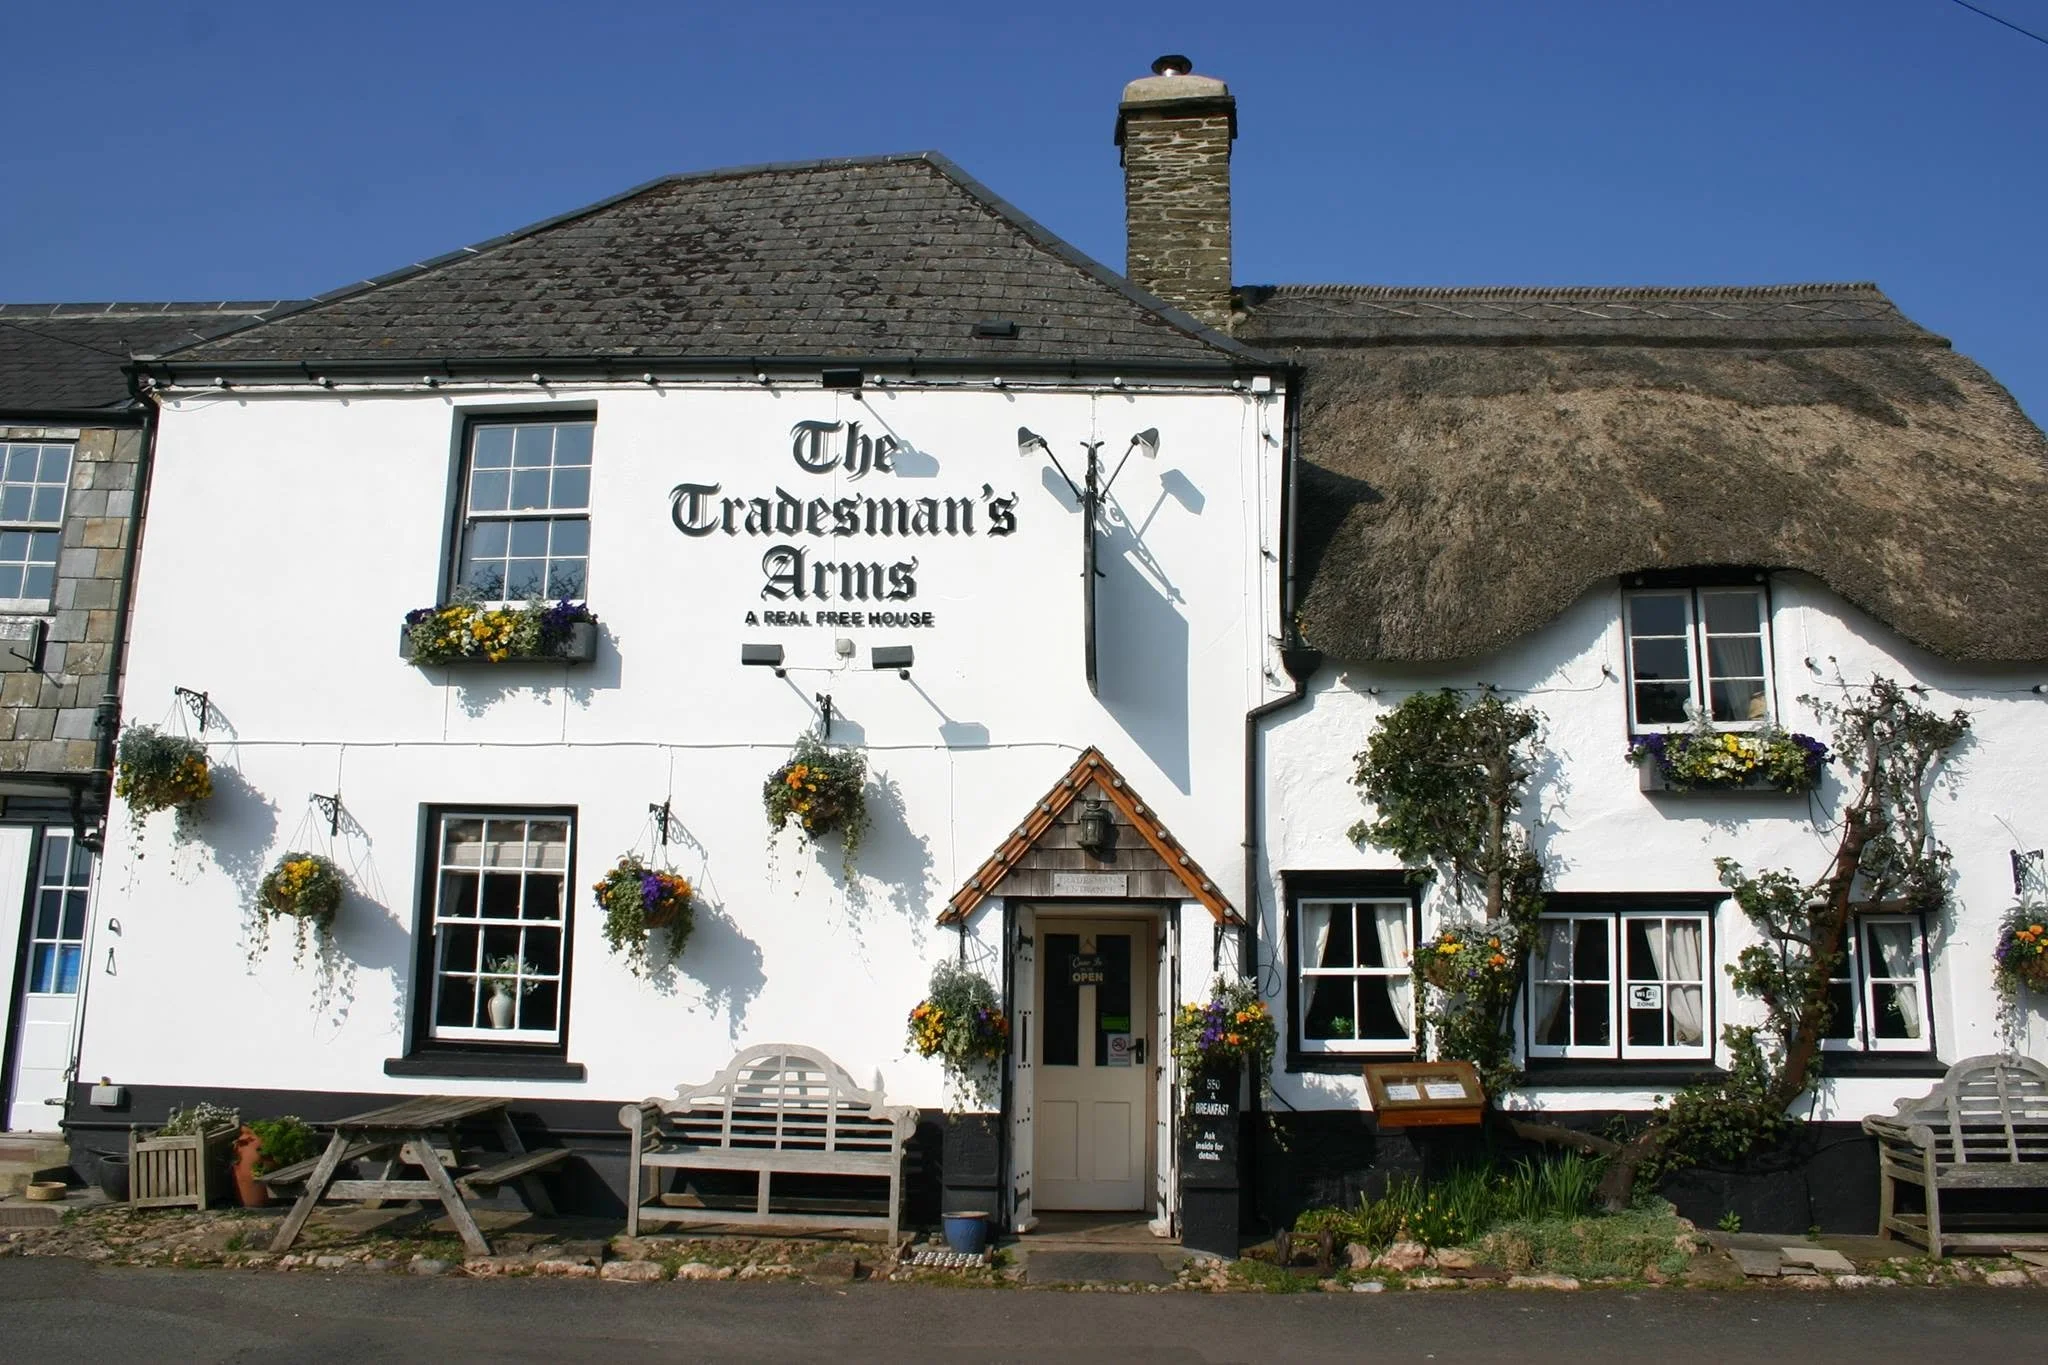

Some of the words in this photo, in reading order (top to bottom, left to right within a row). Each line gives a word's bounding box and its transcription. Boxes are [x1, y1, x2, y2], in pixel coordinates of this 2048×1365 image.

[790, 420, 898, 480] The
[668, 482, 1020, 537] Tradesman's
[760, 544, 920, 602] Arms
[745, 611, 758, 625] A
[764, 611, 811, 626] REAL
[816, 611, 864, 627] FREE
[868, 612, 935, 628] HOUSE
[1072, 972, 1104, 982] OPEN
[1195, 1102, 1229, 1116] BREAKFAST
[1204, 1131, 1216, 1140] Ask
[1215, 1142, 1224, 1151] for
